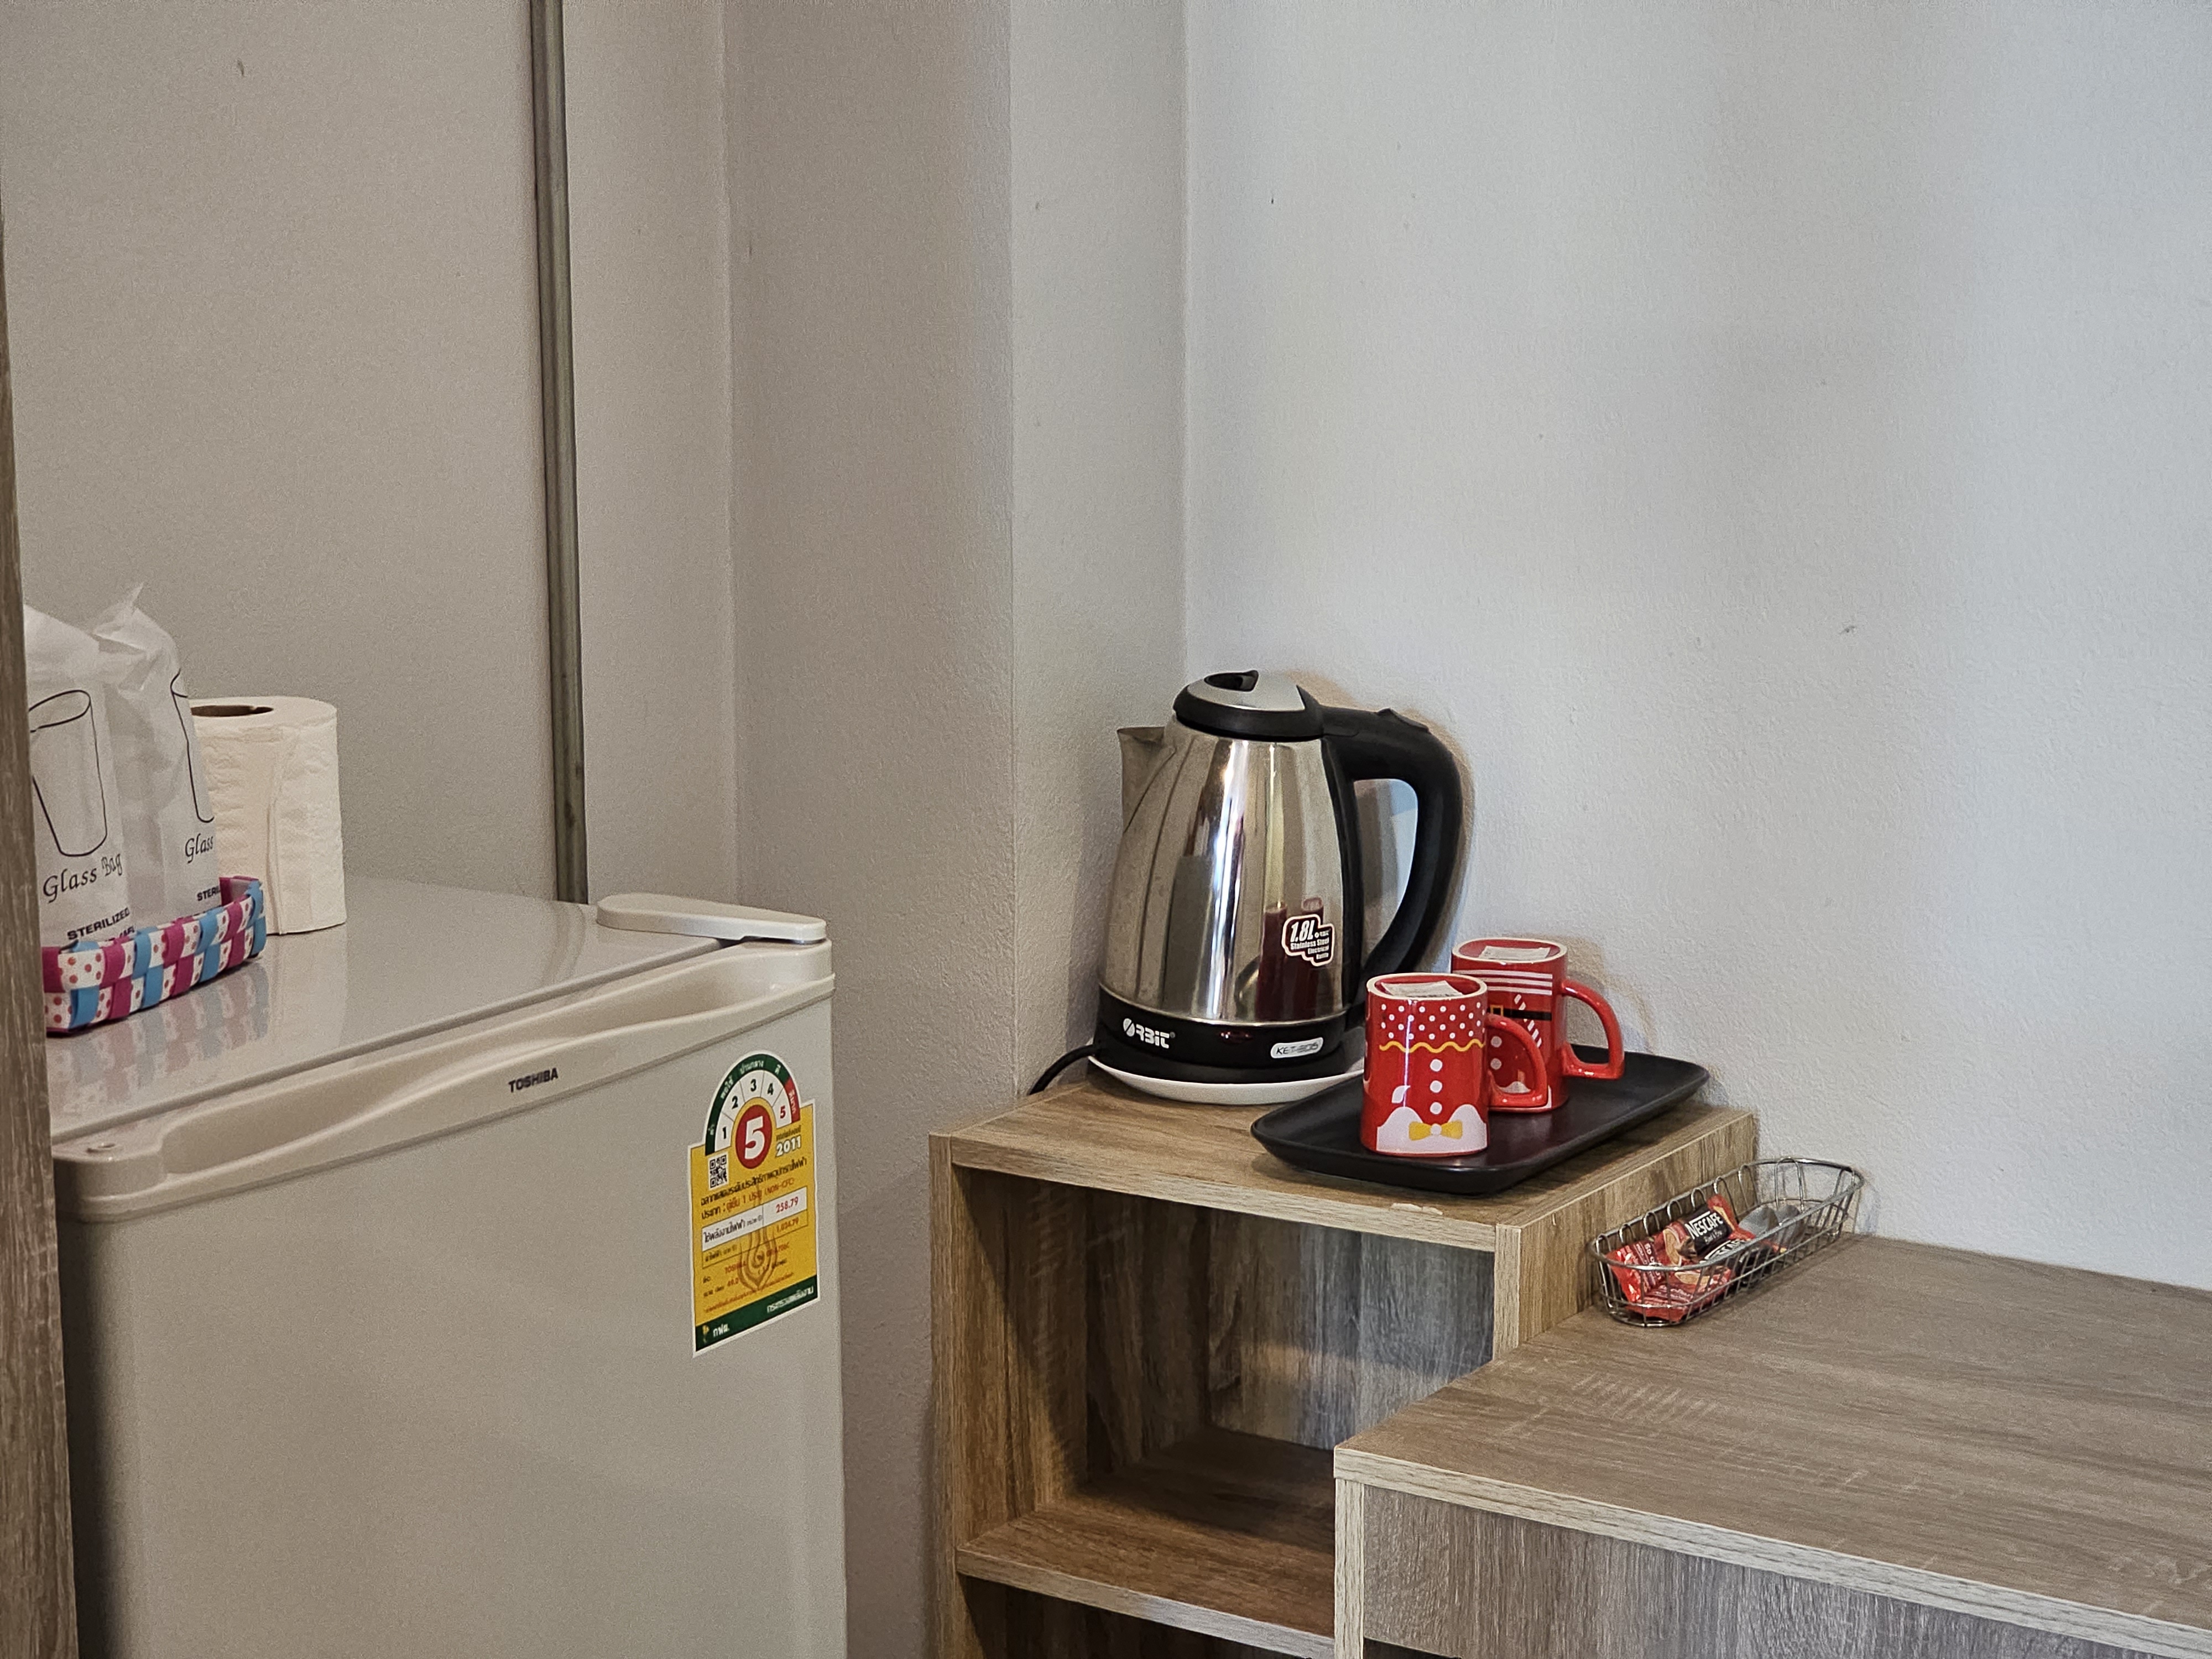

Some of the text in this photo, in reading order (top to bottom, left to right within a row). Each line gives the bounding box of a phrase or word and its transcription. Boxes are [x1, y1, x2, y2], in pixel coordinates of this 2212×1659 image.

[185, 833, 213, 864] Glass
[43, 853, 123, 903] Glass Bag
[67, 907, 131, 940] STERILIZED
[1290, 920, 1315, 943] 1.8L
[508, 1067, 559, 1093] TOSHIBA
[750, 1079, 757, 1092] 3
[767, 1082, 774, 1095] 4
[732, 1095, 738, 1109] 2
[780, 1105, 786, 1119] 5
[722, 1126, 727, 1139] 1
[744, 1115, 765, 1160] 5
[776, 1135, 801, 1157] 2011
[775, 1196, 799, 1213] 258.79
